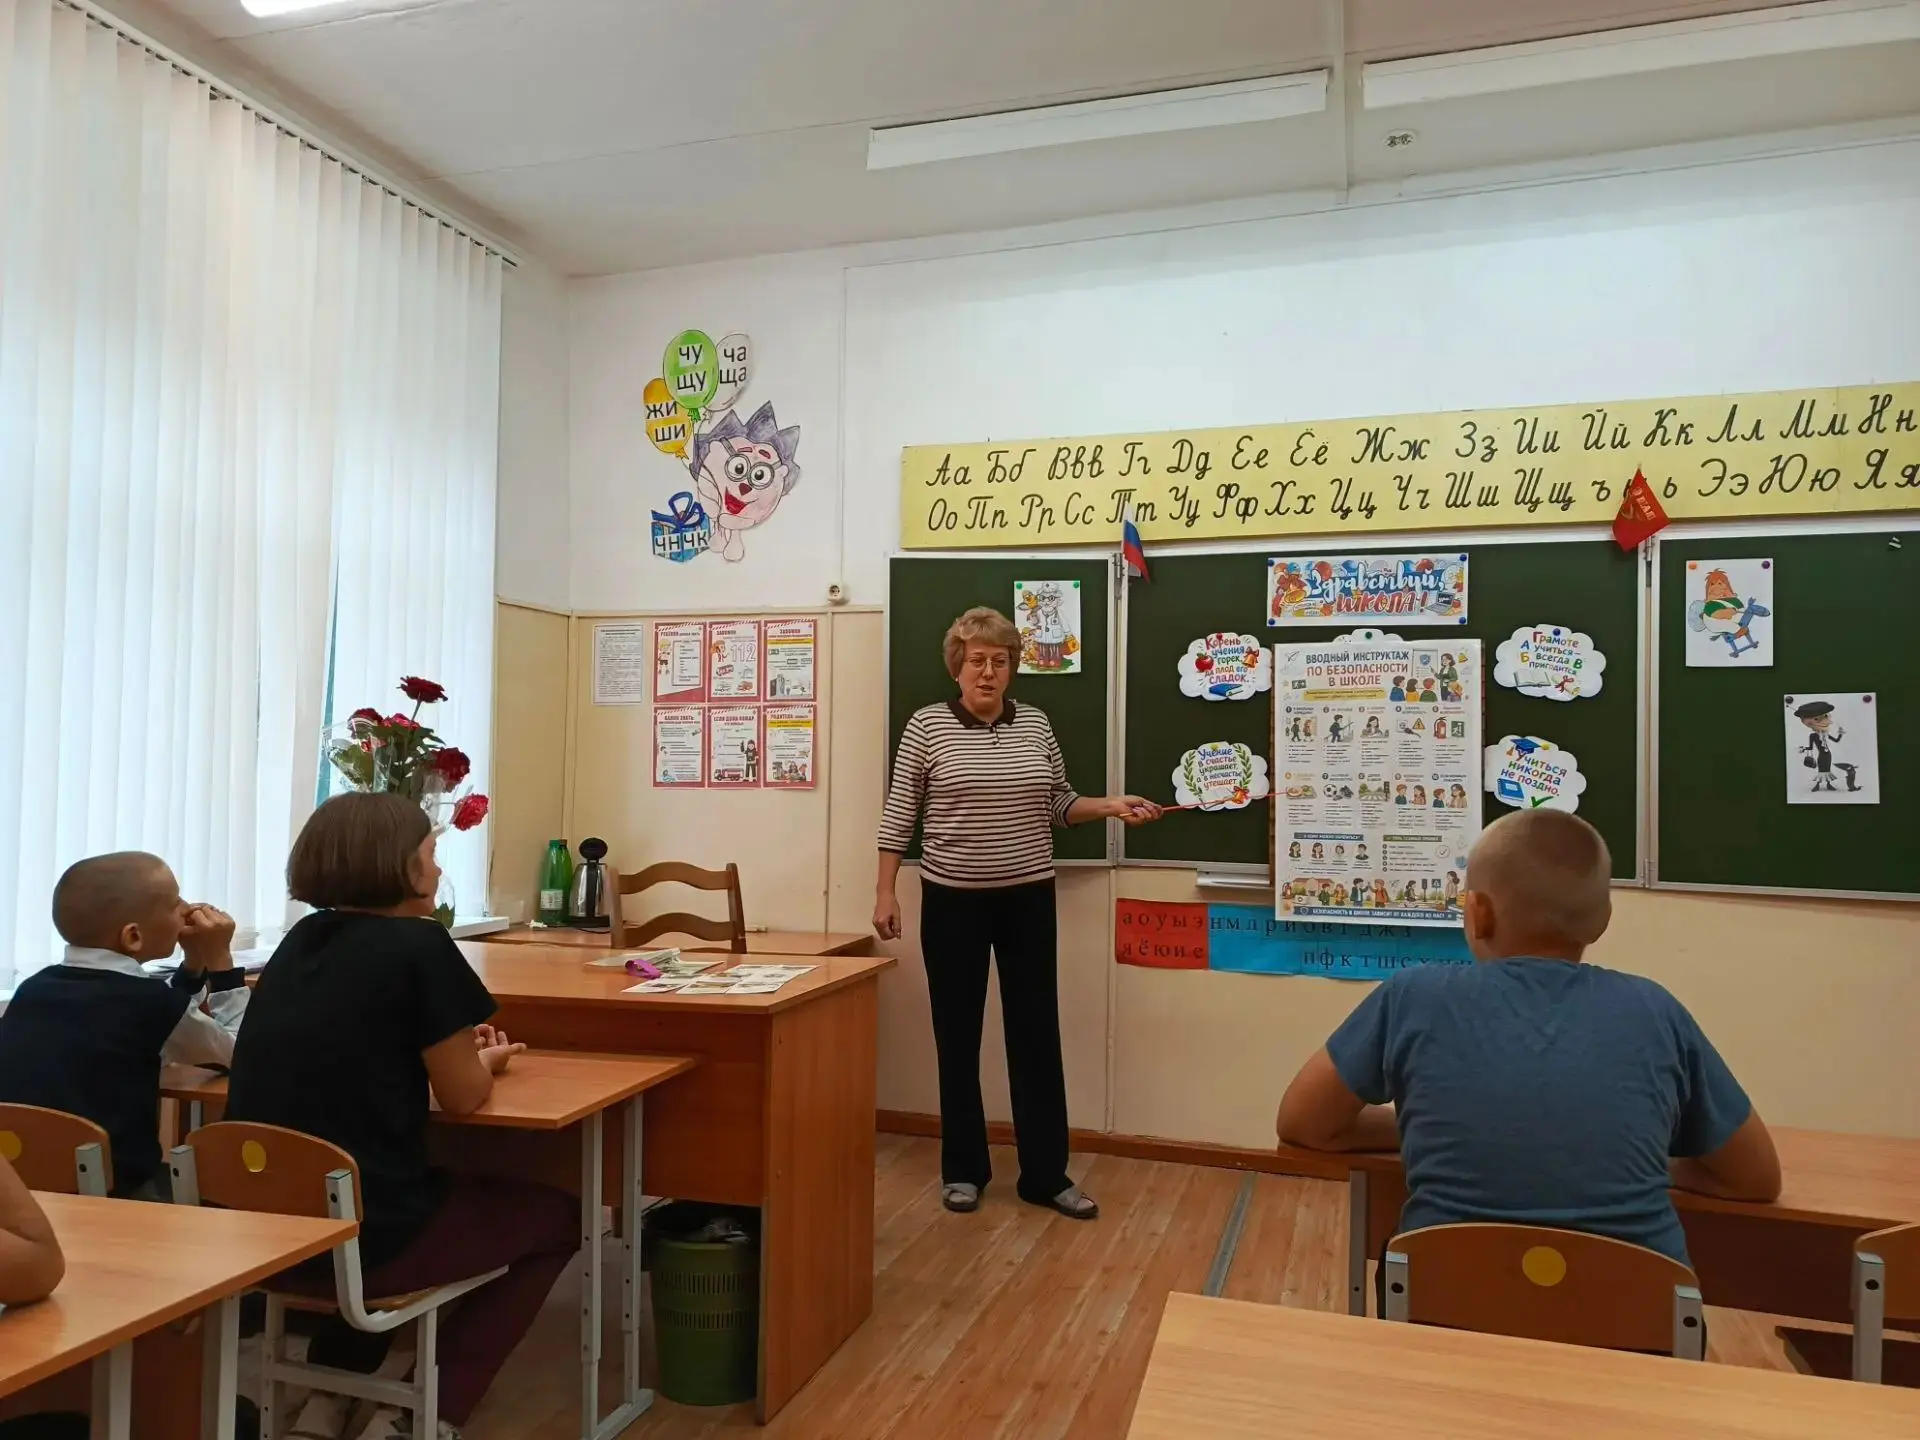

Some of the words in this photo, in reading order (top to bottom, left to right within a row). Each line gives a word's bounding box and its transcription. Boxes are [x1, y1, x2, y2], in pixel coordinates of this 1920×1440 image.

[679, 345, 703, 364] чу
[724, 345, 747, 362] ча
[677, 371, 706, 391] щу
[719, 366, 747, 384] ща
[646, 401, 677, 420] жи
[655, 424, 685, 443] ши
[926, 454, 971, 487] Аа
[987, 448, 1036, 484] Бб
[1231, 434, 1269, 470] Ее
[1289, 427, 1329, 468] Ёё
[1351, 426, 1431, 465] Жж
[1455, 421, 1498, 464] Зз
[1514, 416, 1561, 455] Ии
[1582, 408, 1631, 451] Йй
[1643, 407, 1695, 447] Кк
[1707, 403, 1765, 444] Лл
[1780, 398, 1850, 440] Мм
[1857, 393, 1919, 434] Нн
[928, 497, 968, 532] Оо
[1019, 493, 1056, 534] Рр
[1065, 491, 1096, 526] Сс
[1168, 485, 1201, 528] Уу
[1265, 480, 1317, 517] Хх
[1330, 477, 1378, 521] Цц
[1445, 470, 1500, 509] Шш
[1514, 467, 1577, 514] Щщ
[1698, 457, 1750, 498] Ээ
[1758, 453, 1841, 495] Юю
[1853, 448, 1920, 490] Яя
[1205, 637, 1241, 650] Корень
[1532, 631, 1579, 648] Грамоте
[731, 643, 757, 662] 112
[1212, 646, 1244, 659] учения
[1306, 651, 1349, 664] ВВОДНЫЙ
[1353, 651, 1409, 661] ИНСТРУКТАЖ
[1536, 653, 1569, 664] всегда
[1307, 666, 1322, 676] ПО
[1327, 663, 1408, 675] БЕЗОПАСНОСТИ
[1329, 677, 1336, 686] В
[1340, 675, 1381, 686] ШКОЛЕ
[1198, 748, 1232, 760] Учение
[1516, 750, 1567, 777] Учиться
[1500, 769, 1515, 779] не
[1508, 761, 1561, 785] никогда
